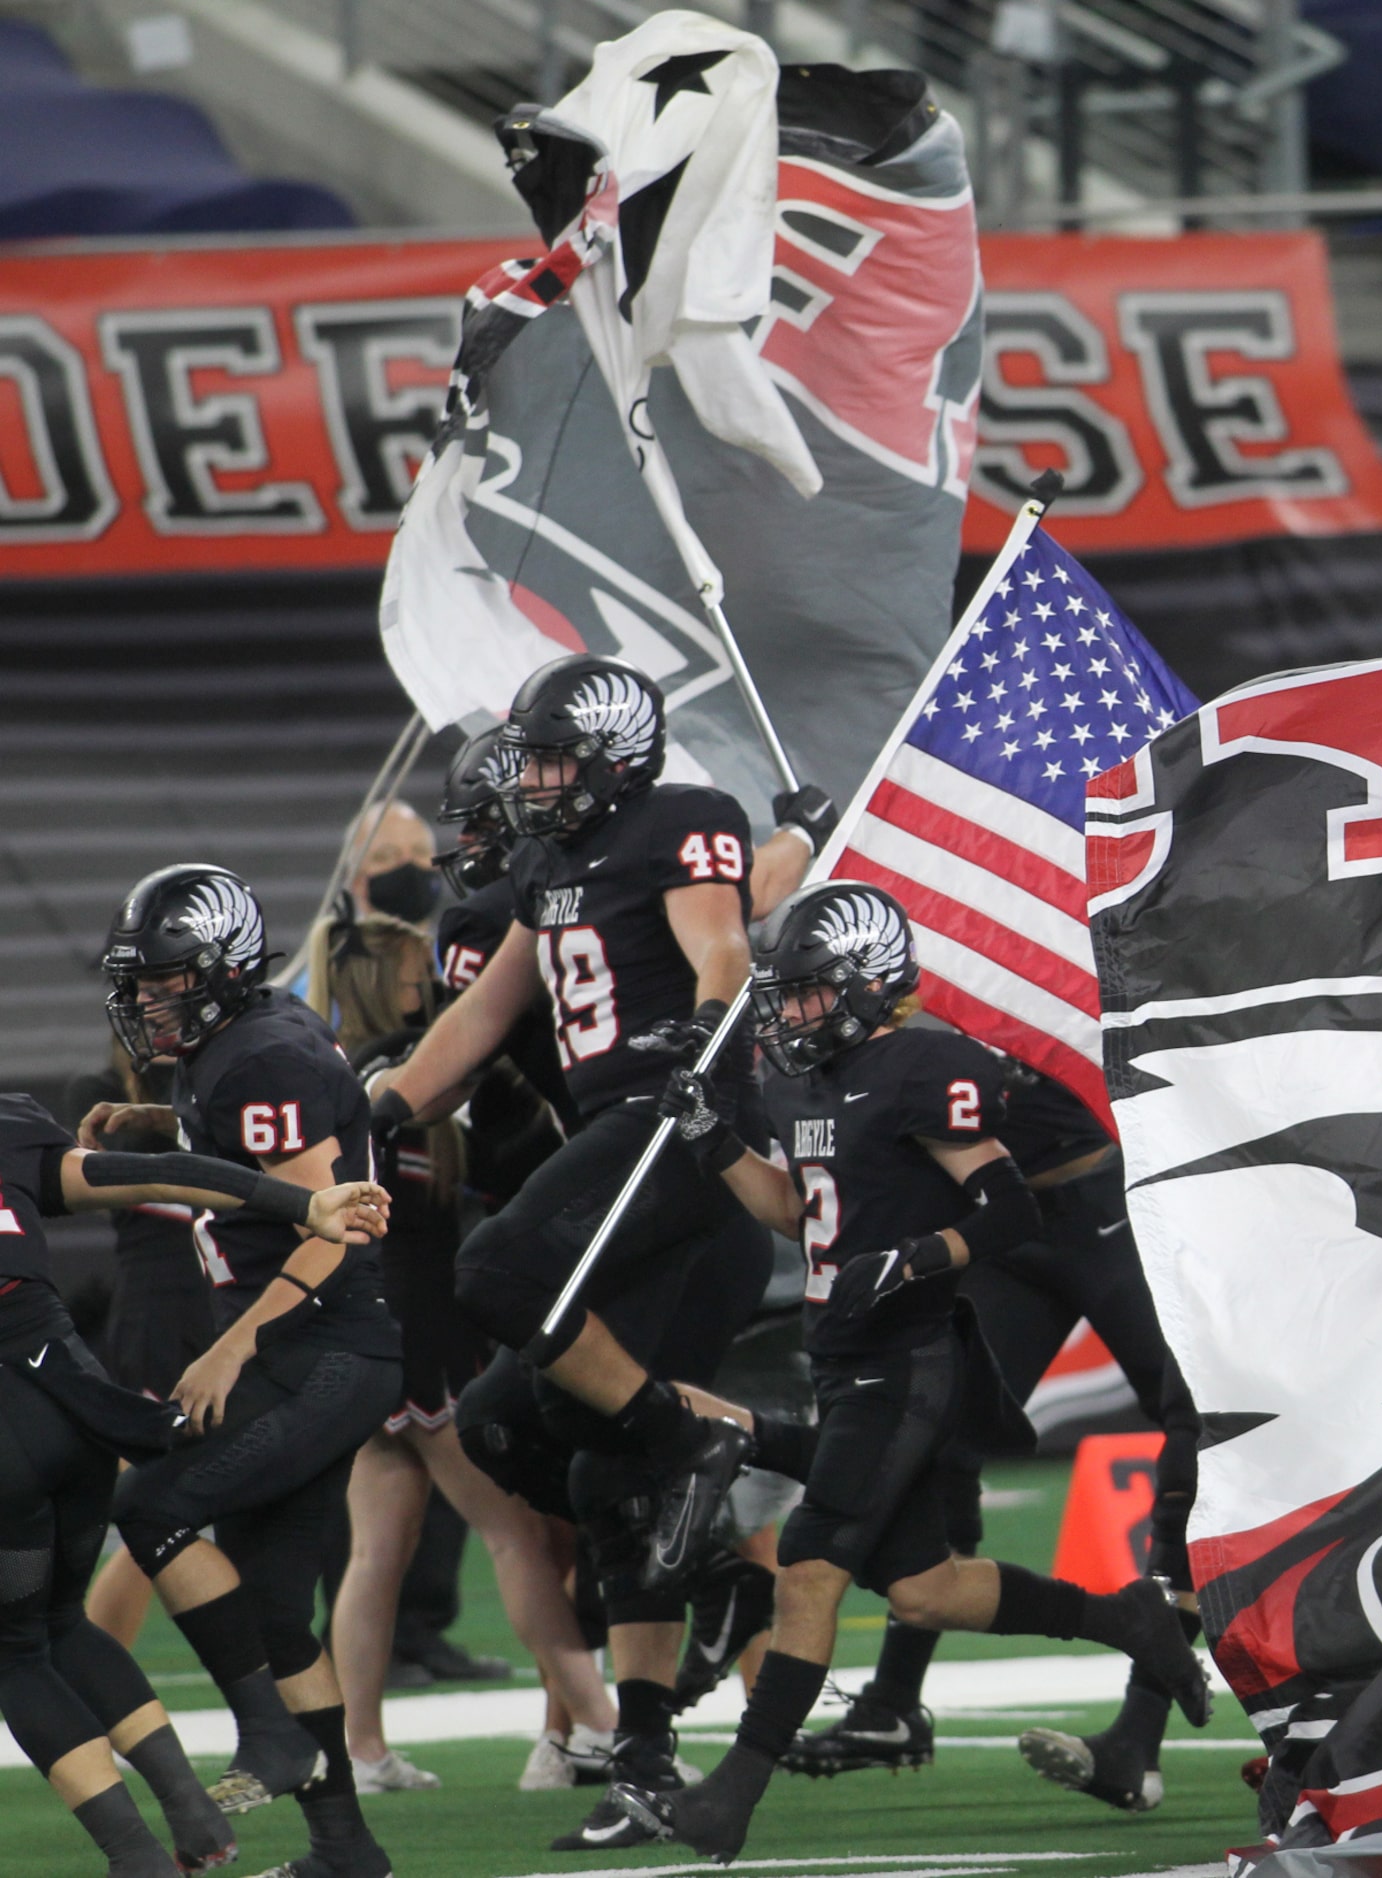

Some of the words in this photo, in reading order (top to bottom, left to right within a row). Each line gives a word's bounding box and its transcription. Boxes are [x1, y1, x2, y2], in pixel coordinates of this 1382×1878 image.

[678, 833, 744, 881] 49
[241, 1100, 305, 1154] 61
[947, 1079, 982, 1131] 2
[794, 1118, 835, 1158] ARGYLE
